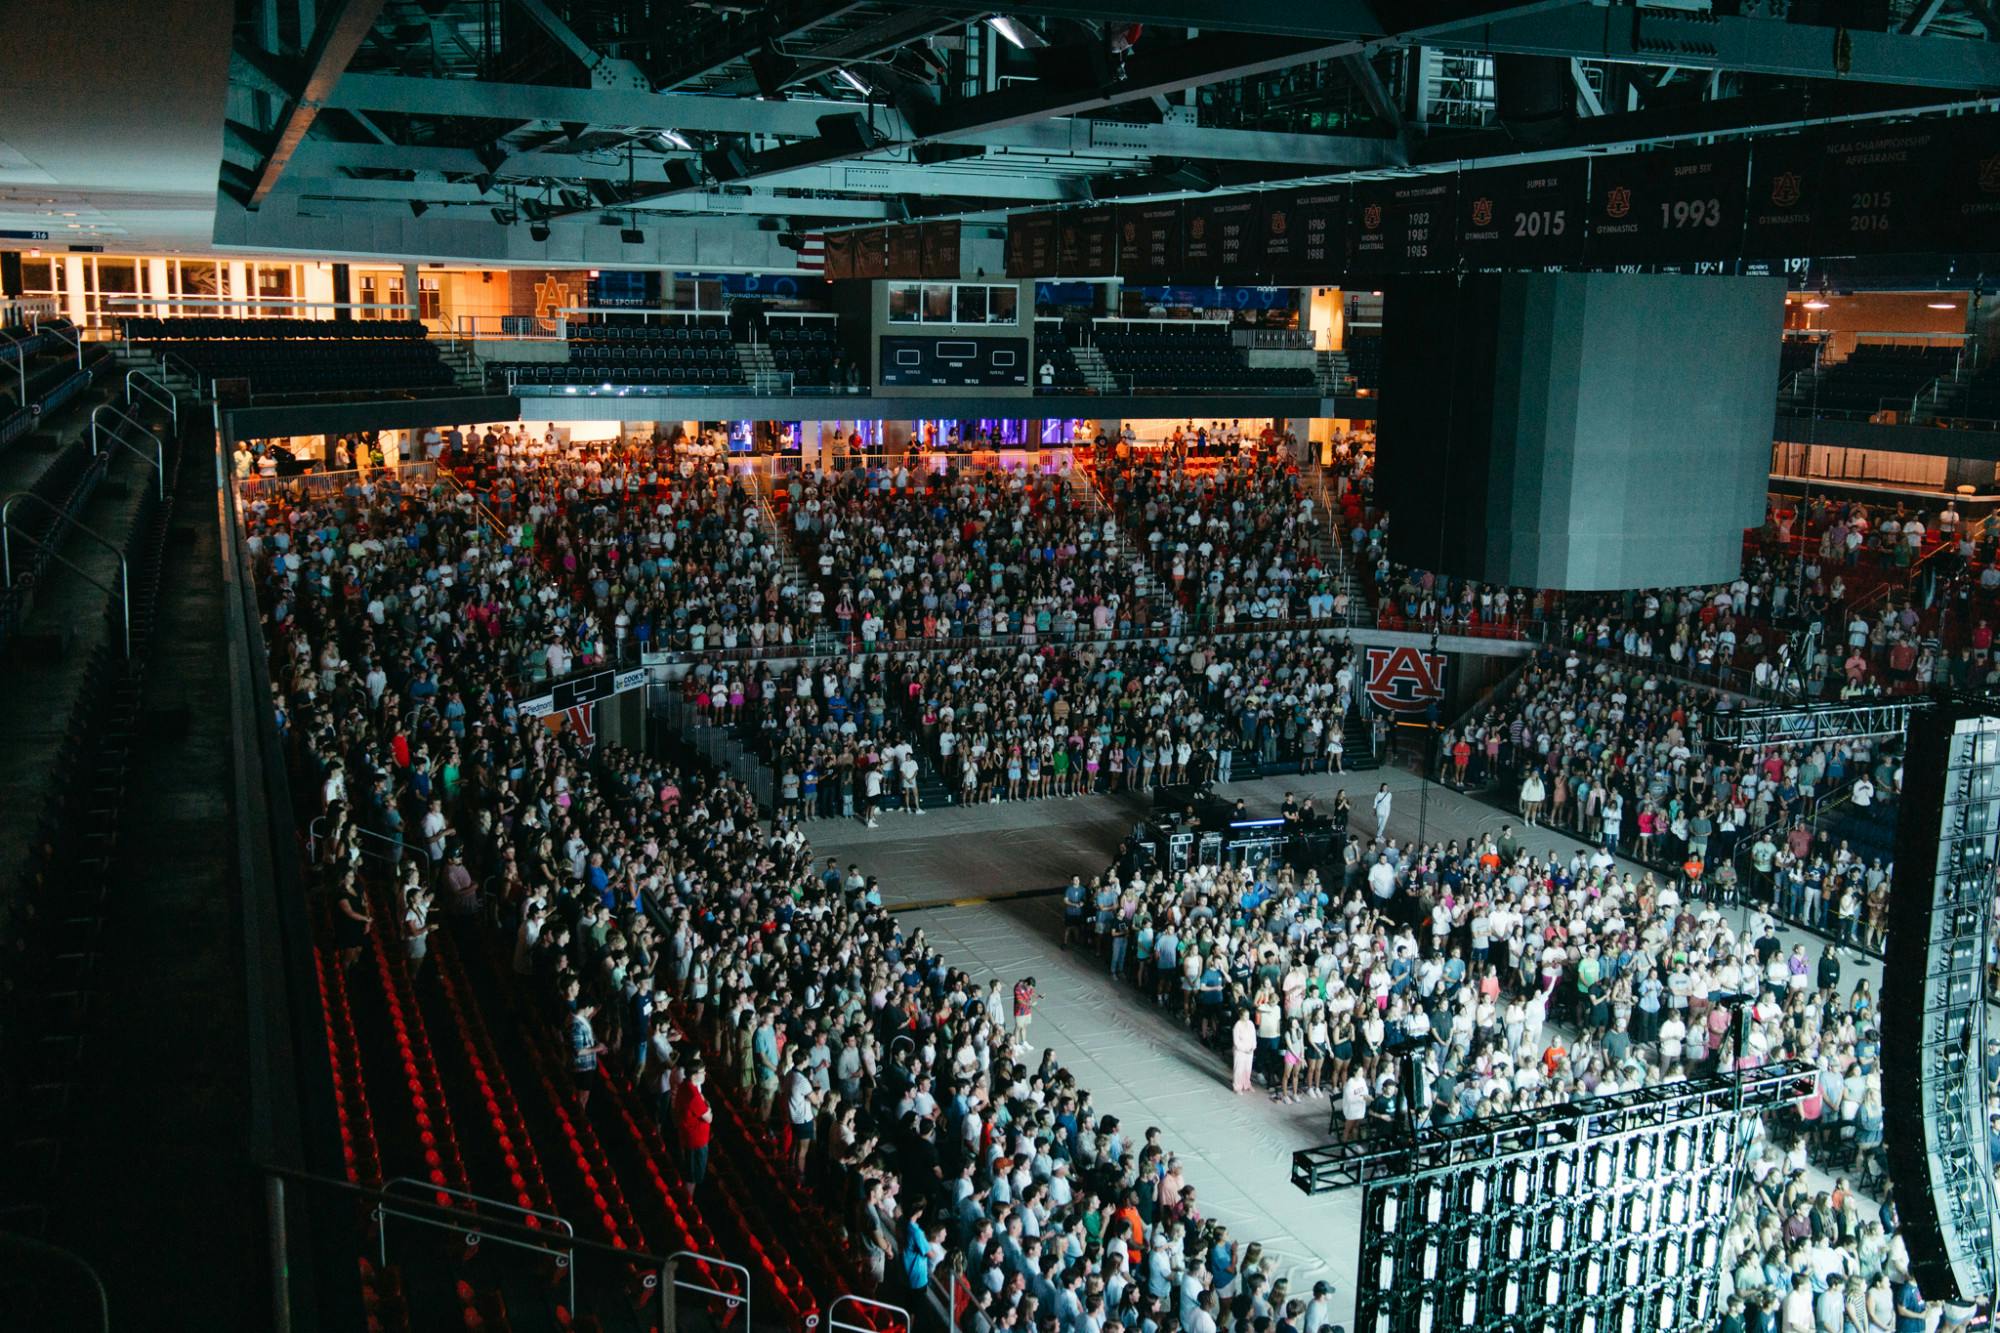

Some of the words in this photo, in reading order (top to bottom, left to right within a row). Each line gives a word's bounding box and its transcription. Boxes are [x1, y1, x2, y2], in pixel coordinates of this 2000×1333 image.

[1851, 191, 1891, 209] 2015
[1408, 212, 1430, 225] 1982
[1660, 198, 1721, 229] 1993
[1514, 210, 1565, 237] 2015
[1850, 214, 1889, 231] 2016
[32, 232, 46, 240] 216
[1407, 245, 1428, 257] 1985
[624, 672, 644, 684] COOK'S
